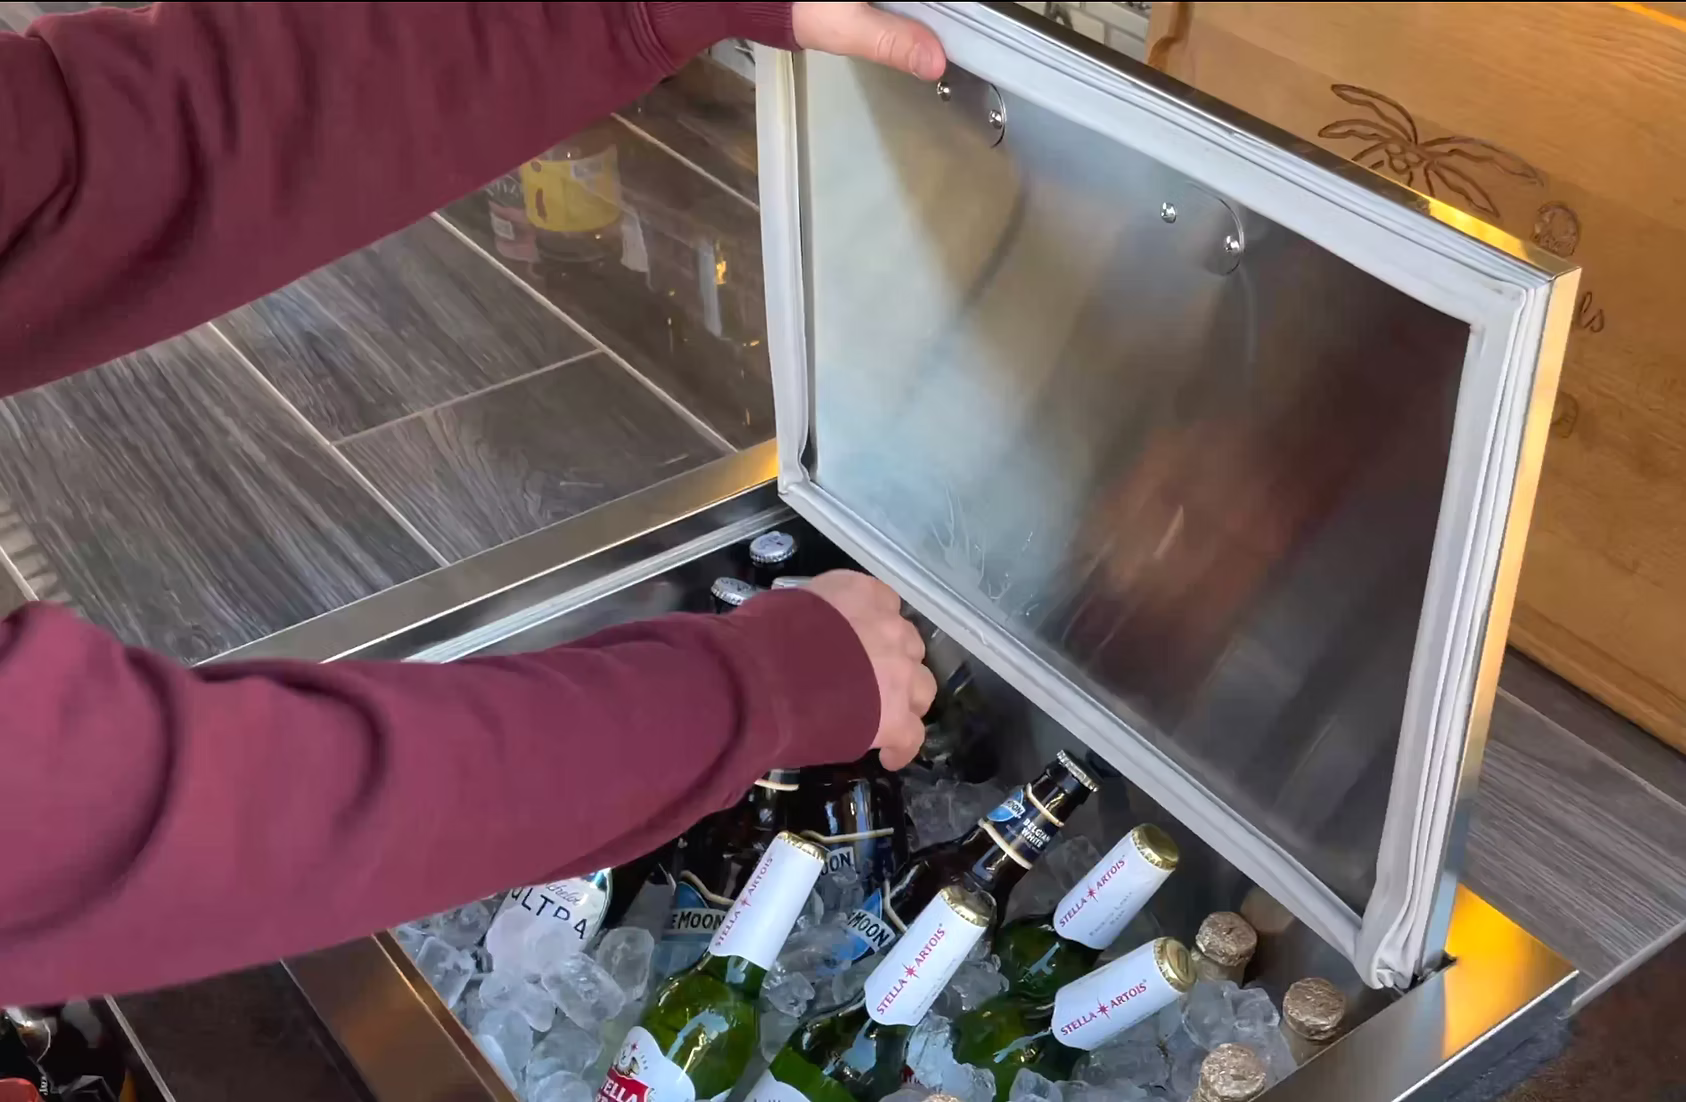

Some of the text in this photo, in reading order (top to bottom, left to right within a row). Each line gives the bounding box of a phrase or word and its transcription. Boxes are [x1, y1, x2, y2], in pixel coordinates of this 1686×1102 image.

[1021, 827, 1043, 848] WHITE
[715, 854, 774, 947] STELLA ARTOIS
[1059, 897, 1087, 928] STELLA
[1096, 858, 1126, 890] ARTOIS
[848, 911, 890, 947] MOON
[876, 978, 908, 1016] STELLA
[914, 928, 946, 968] ARTOIS
[1060, 982, 1147, 1036] STELLA ARTOIS
